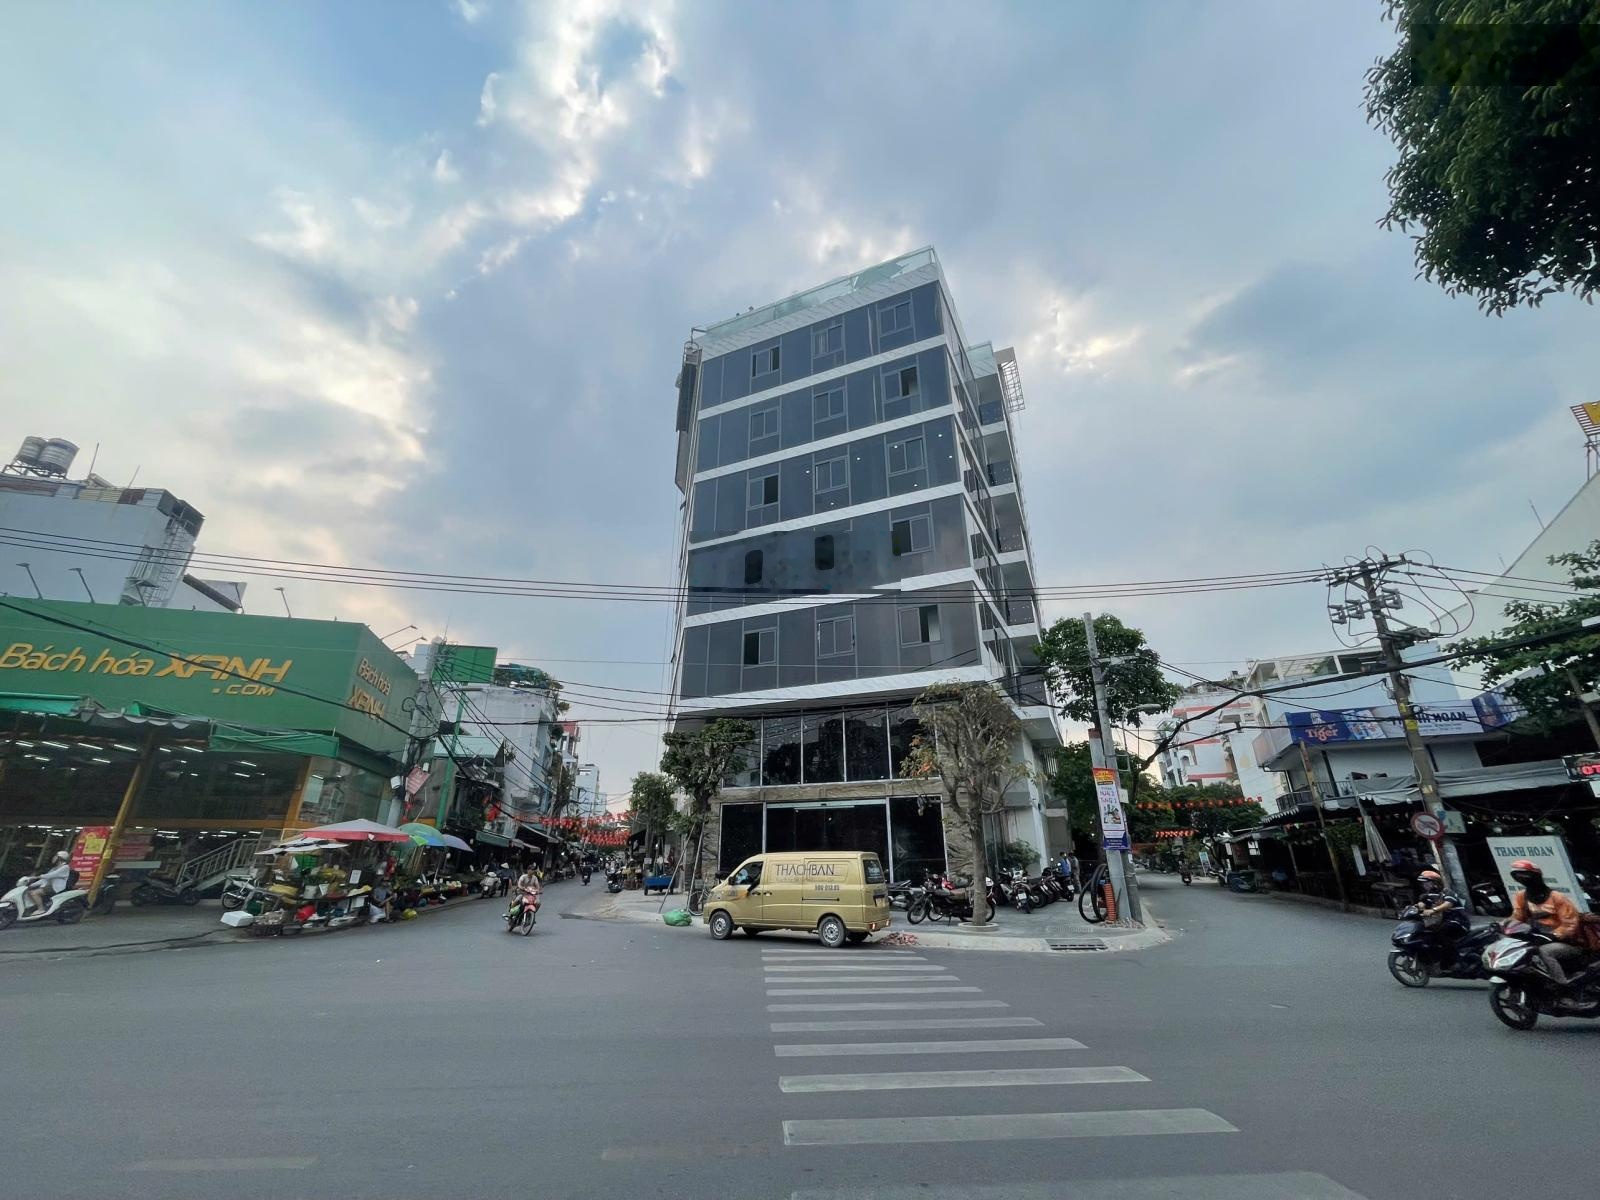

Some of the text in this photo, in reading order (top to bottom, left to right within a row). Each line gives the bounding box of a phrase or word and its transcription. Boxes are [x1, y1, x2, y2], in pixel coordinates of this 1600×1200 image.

[0, 642, 293, 683] Bách hóa XANH
[1304, 724, 1339, 742] Tiger
[1494, 846, 1527, 857] THANH
